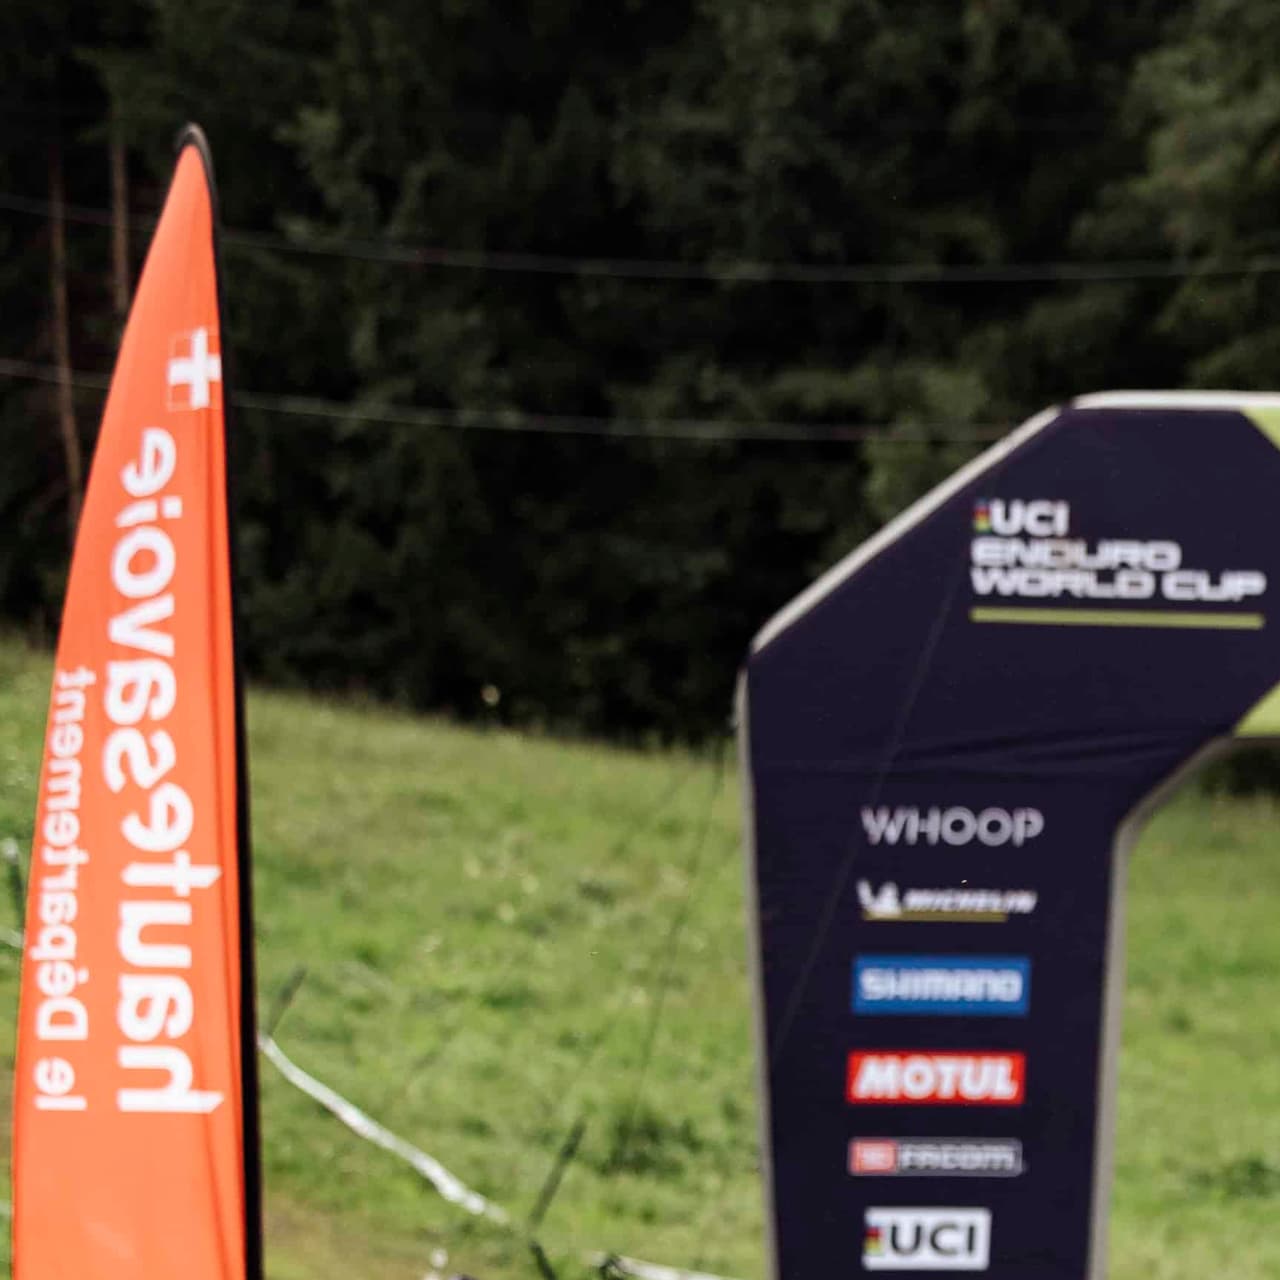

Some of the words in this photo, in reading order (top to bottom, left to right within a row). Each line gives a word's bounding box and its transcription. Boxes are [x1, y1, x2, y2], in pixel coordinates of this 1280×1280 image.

[989, 500, 1070, 536] UCI
[970, 538, 1182, 570] ENDURO
[970, 567, 1156, 599] WORLD
[1161, 571, 1268, 601] CUP
[860, 805, 1045, 847] WHOOP
[852, 1054, 1019, 1100] MOTUL
[889, 1222, 978, 1256] UCI
